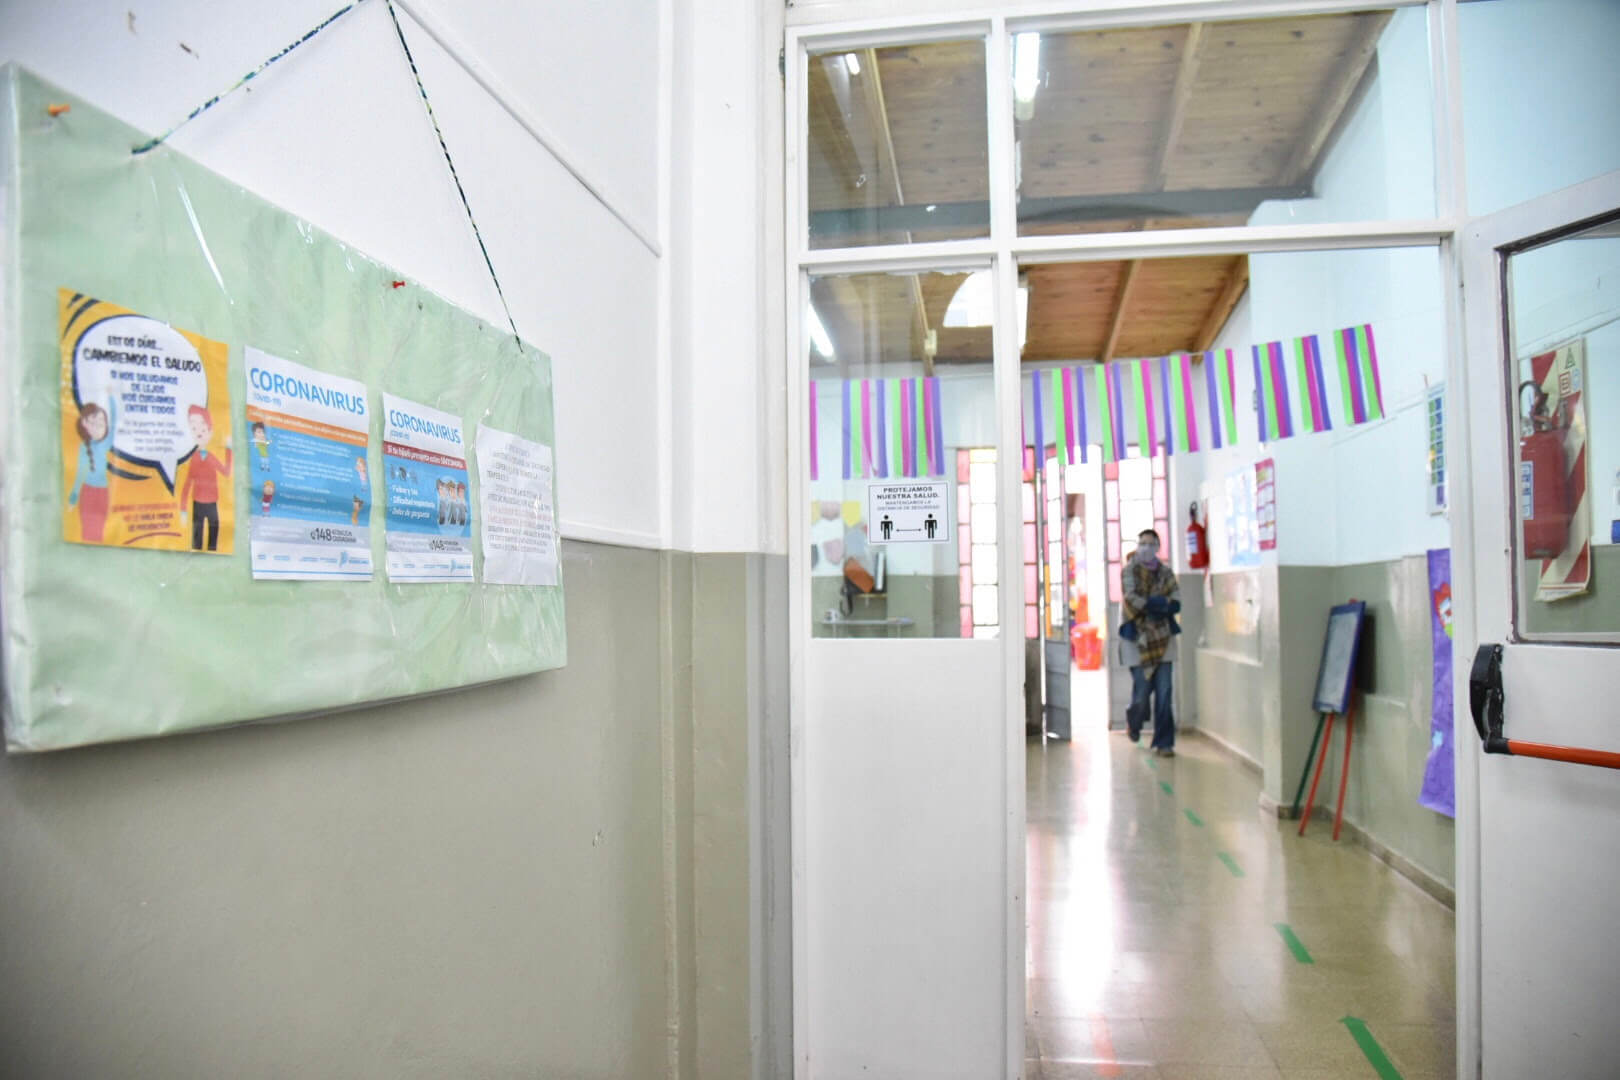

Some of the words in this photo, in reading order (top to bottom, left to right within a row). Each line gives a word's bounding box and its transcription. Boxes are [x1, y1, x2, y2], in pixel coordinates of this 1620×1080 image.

[83, 348, 148, 367] CAMBIEMOS
[151, 356, 161, 368] EL
[165, 357, 202, 373] SALUDO
[250, 367, 364, 416] CORONAVIRUS
[390, 409, 462, 444] CORONAVIRUS
[316, 528, 332, 542] 148
